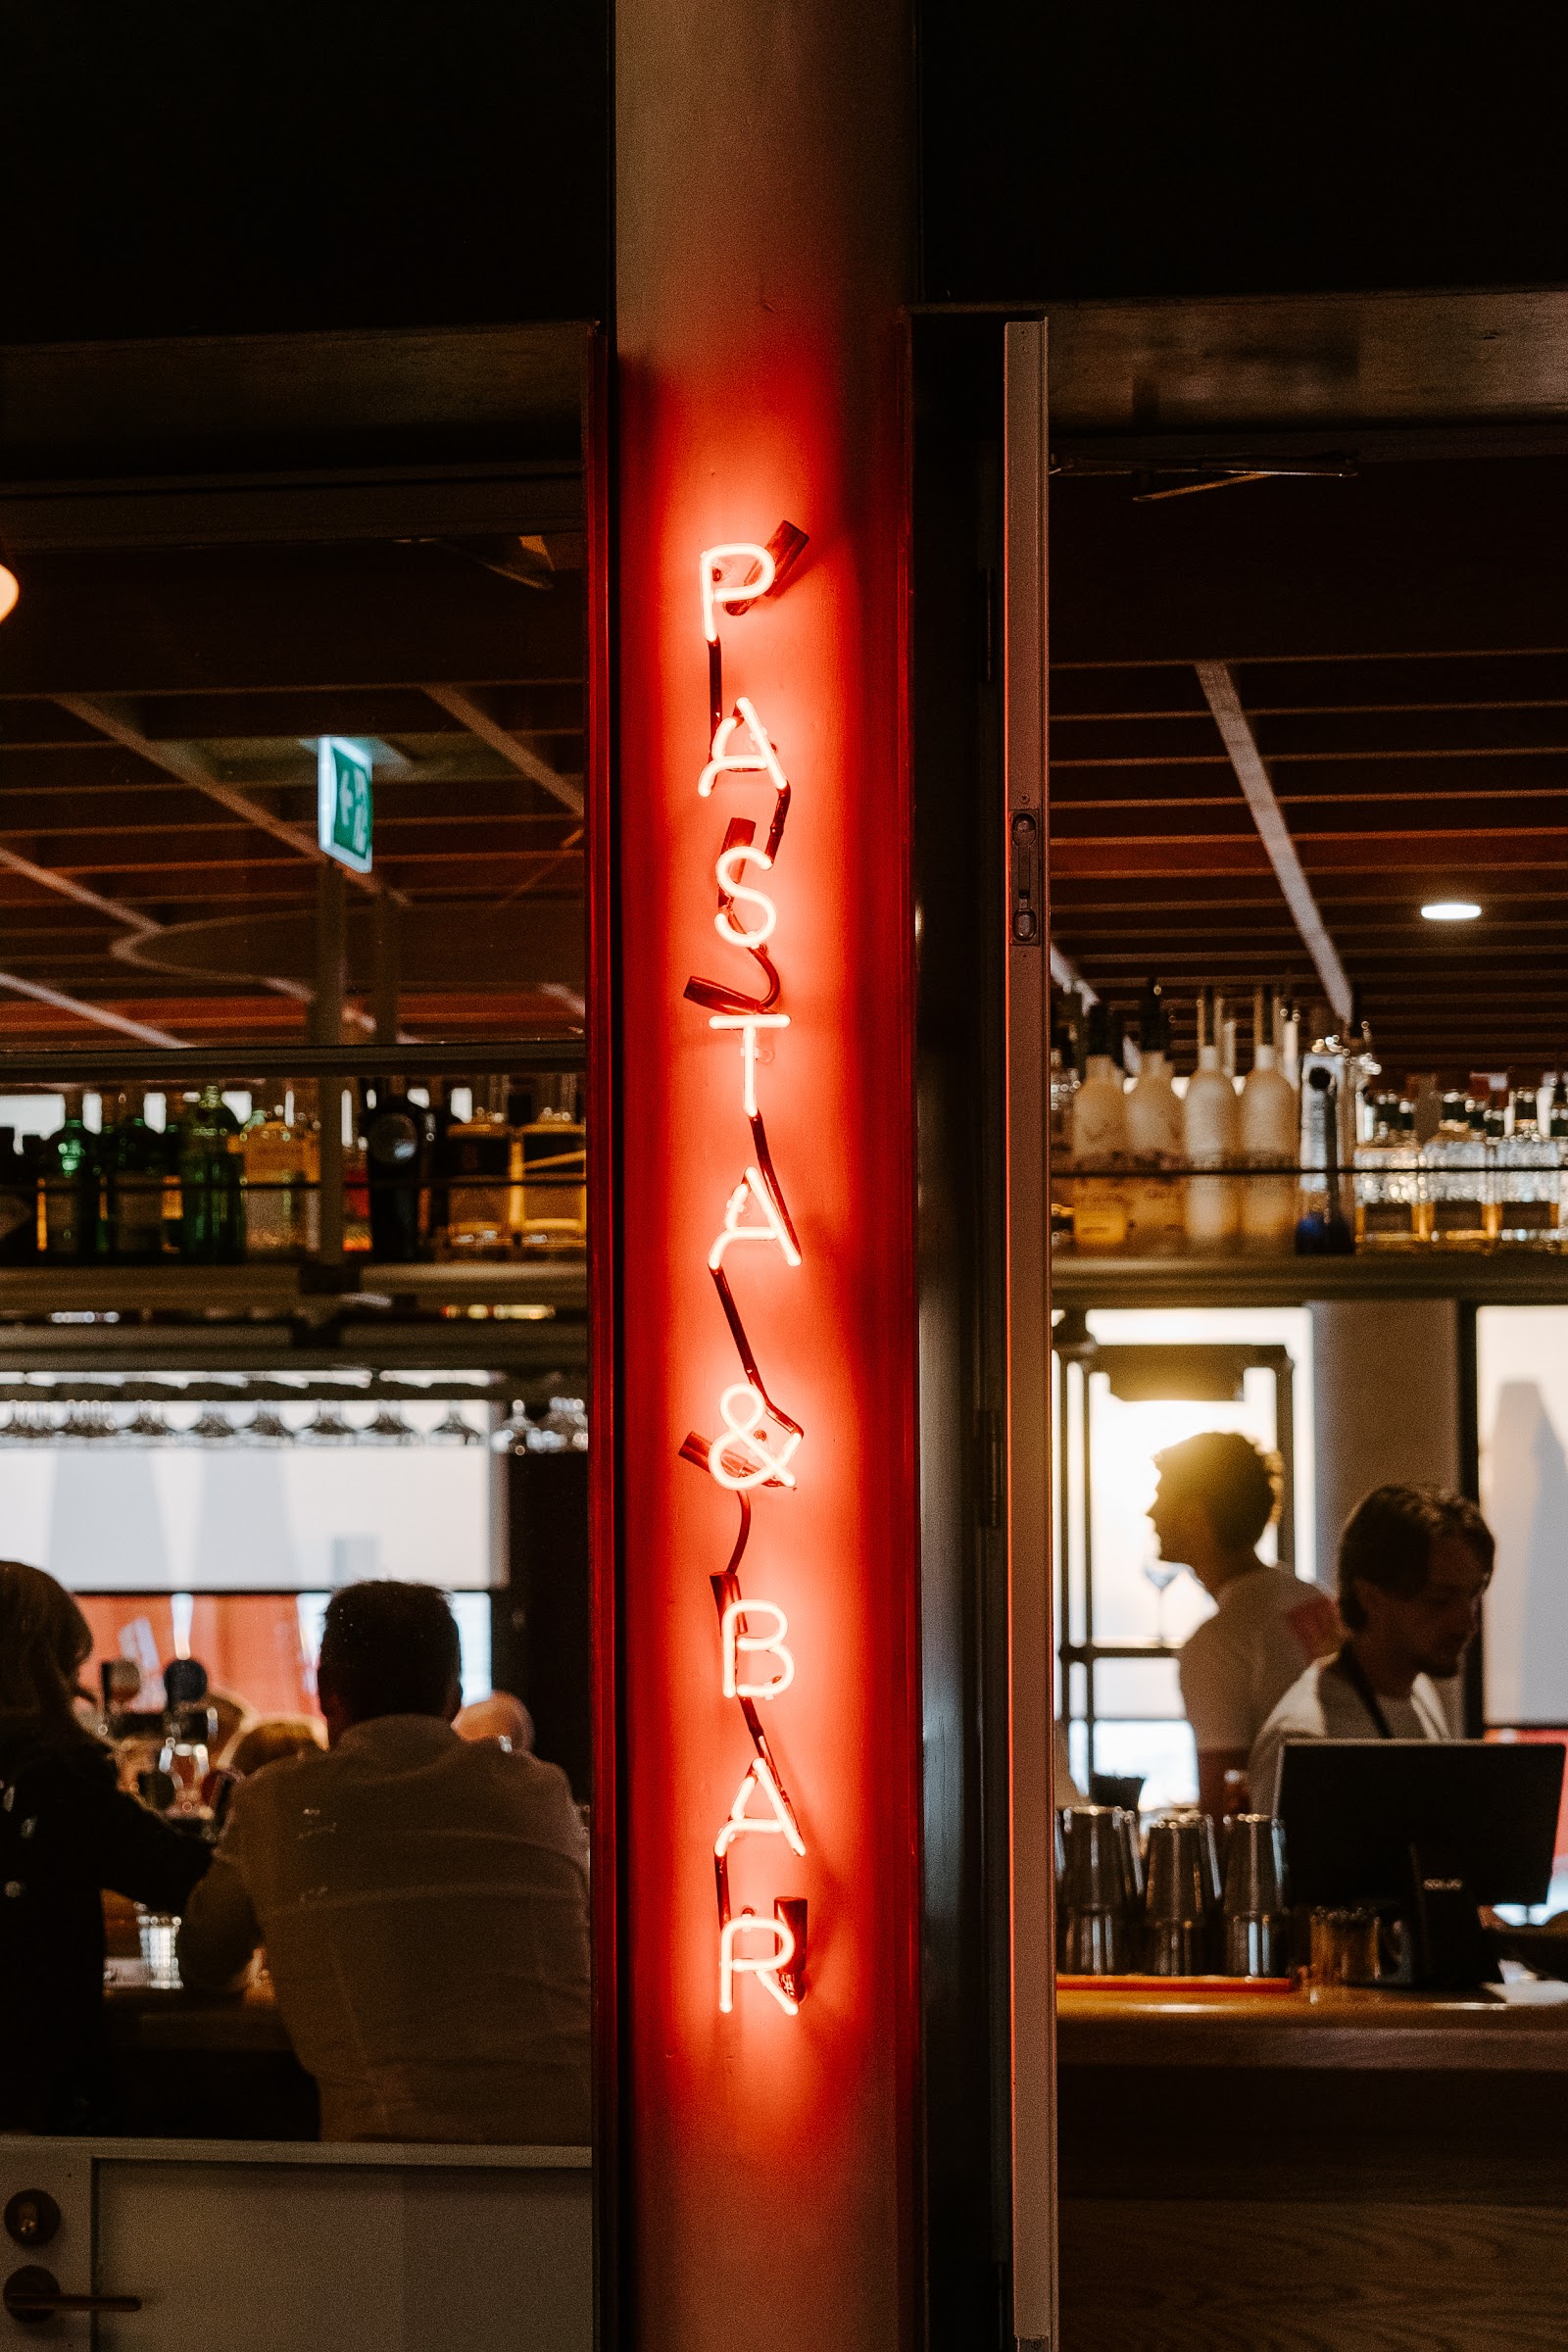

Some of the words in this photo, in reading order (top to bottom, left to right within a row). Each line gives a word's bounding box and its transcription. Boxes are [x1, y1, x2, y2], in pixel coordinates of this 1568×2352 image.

[699, 543, 802, 1266] PASTA
[709, 1383, 803, 1490] &
[713, 1598, 806, 2016] BAR
